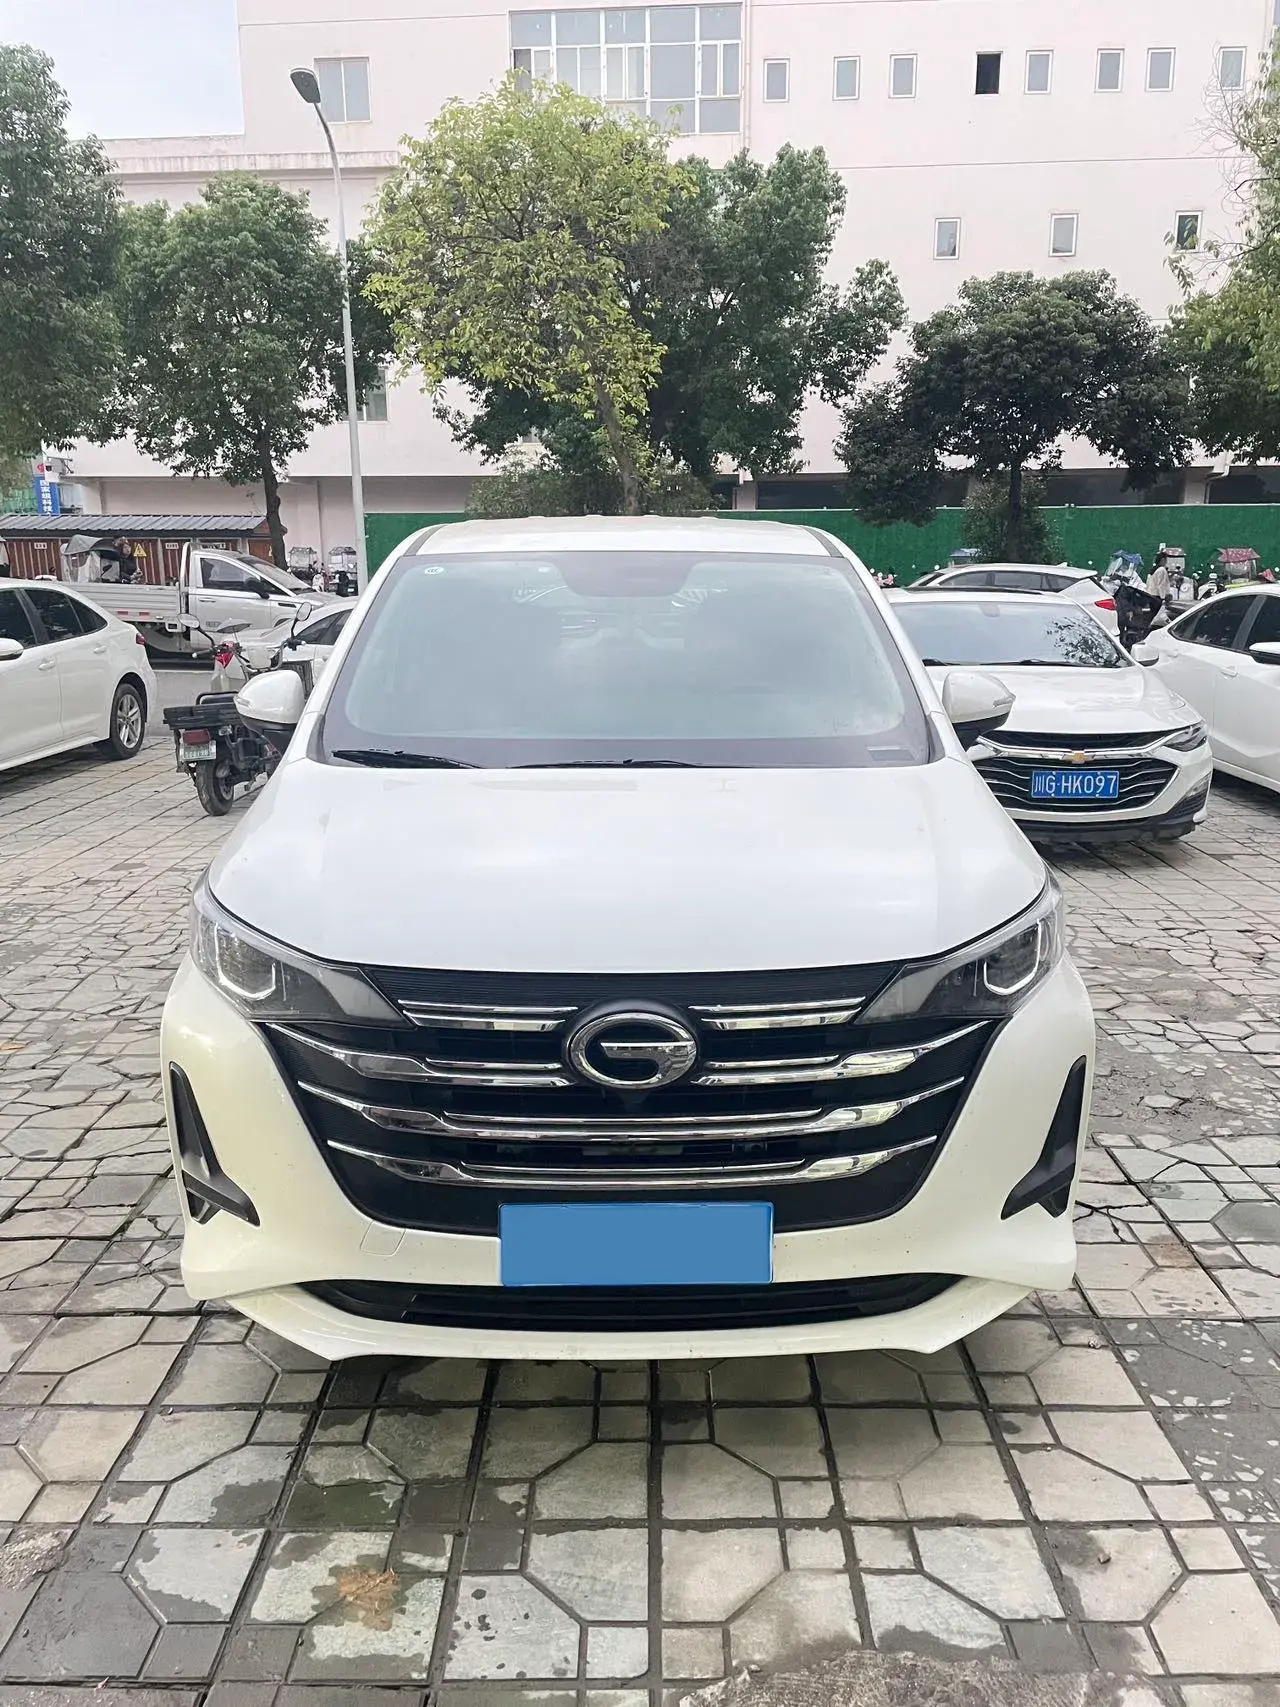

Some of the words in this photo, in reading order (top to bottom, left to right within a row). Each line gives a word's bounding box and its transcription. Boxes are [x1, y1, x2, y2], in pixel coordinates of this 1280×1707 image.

[40, 479, 53, 515] 国家级科技
